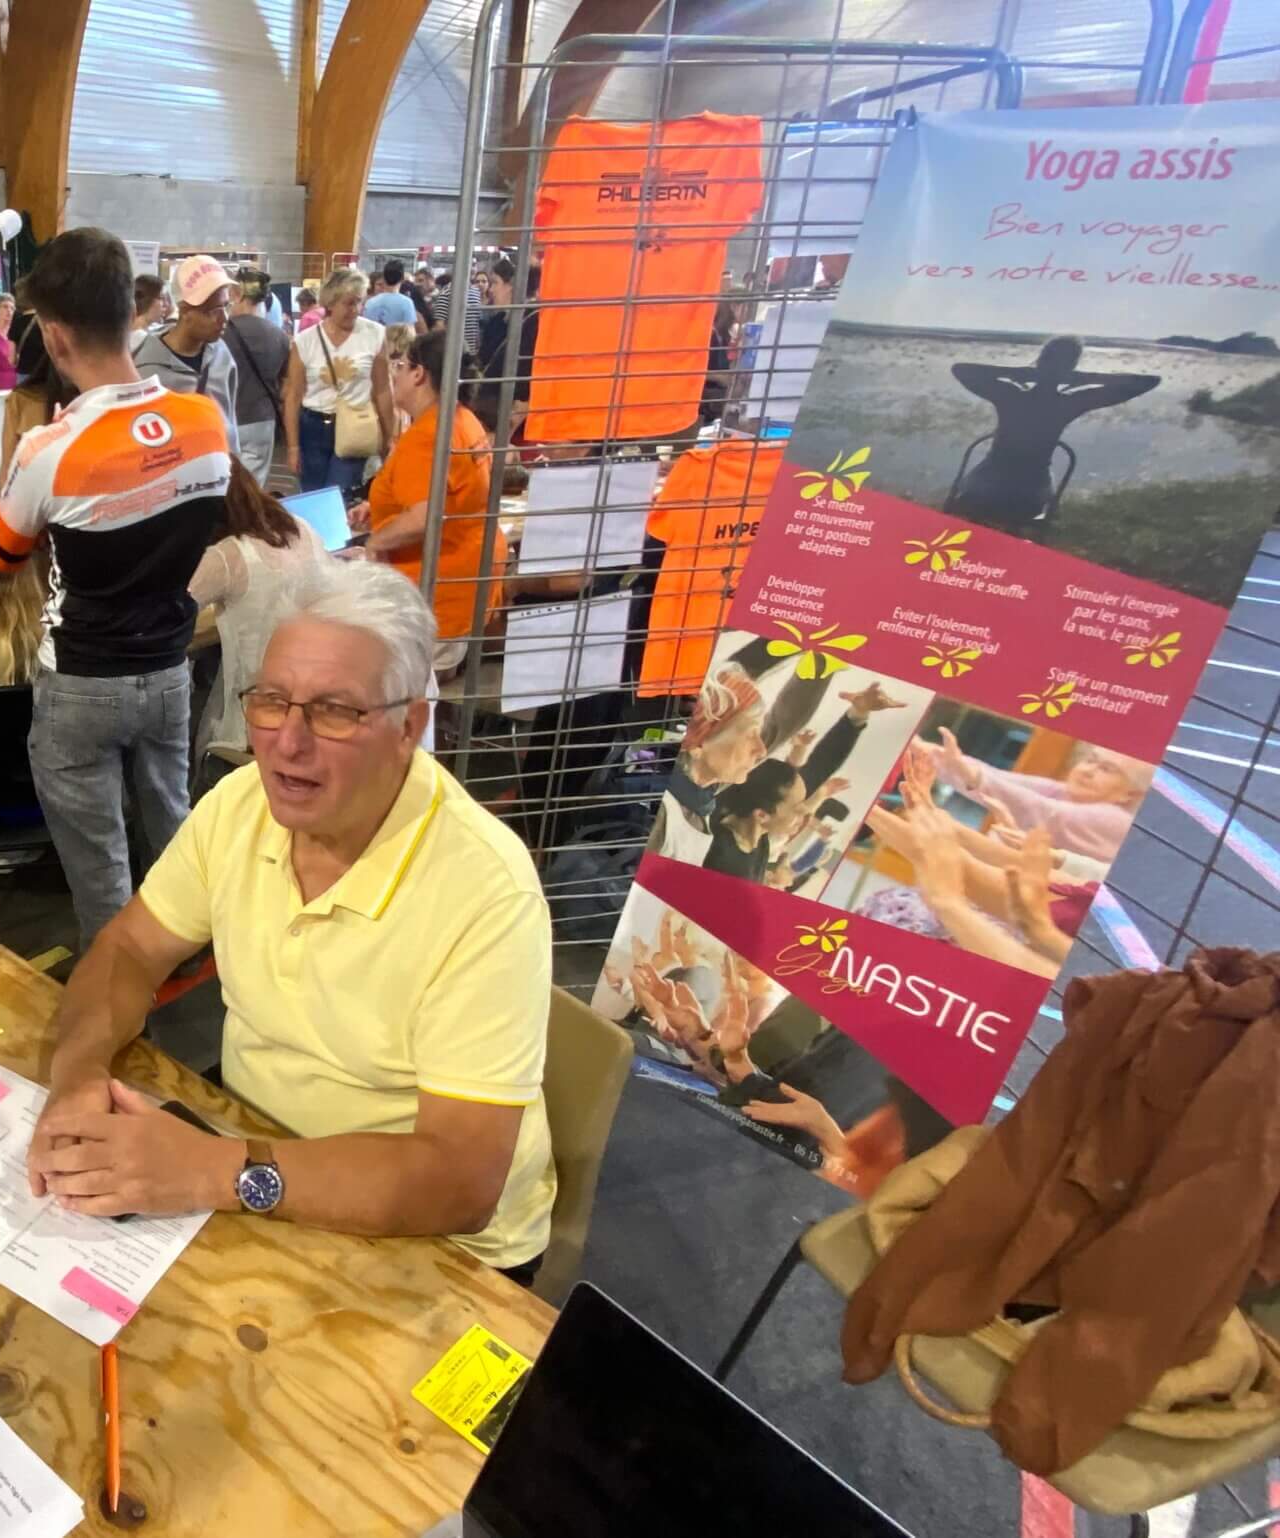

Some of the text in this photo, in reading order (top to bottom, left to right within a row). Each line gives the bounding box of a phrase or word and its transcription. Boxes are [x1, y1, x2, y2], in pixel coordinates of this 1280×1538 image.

[1025, 137, 1237, 191] Yoga assis
[983, 202, 1229, 255] Bien voyager
[907, 263, 974, 279] vers
[988, 251, 1088, 283] notre
[138, 421, 164, 441] U
[812, 496, 865, 515] Se mettre
[793, 510, 875, 531] en mouvement
[784, 522, 872, 547] par des postures
[798, 539, 847, 558] adaptées
[952, 558, 1008, 580] Déployer
[767, 574, 826, 597] Développer
[920, 569, 1029, 600] et libérer le souffle
[758, 588, 825, 612] la conscience
[1063, 584, 1181, 619] Stimuler l'énergie
[749, 601, 823, 627] des sensations
[892, 606, 926, 625] Eviter
[1071, 605, 1097, 620] par
[1097, 607, 1116, 624] les
[876, 620, 1001, 655] renforcer le lien social
[1063, 618, 1151, 647] la voix, le rire
[1047, 666, 1169, 707] S'offrir un moment
[1070, 691, 1134, 715] méditatif
[829, 946, 1011, 1054] NASTIE
[793, 1142, 808, 1159] 06
[808, 1149, 820, 1164] 15
